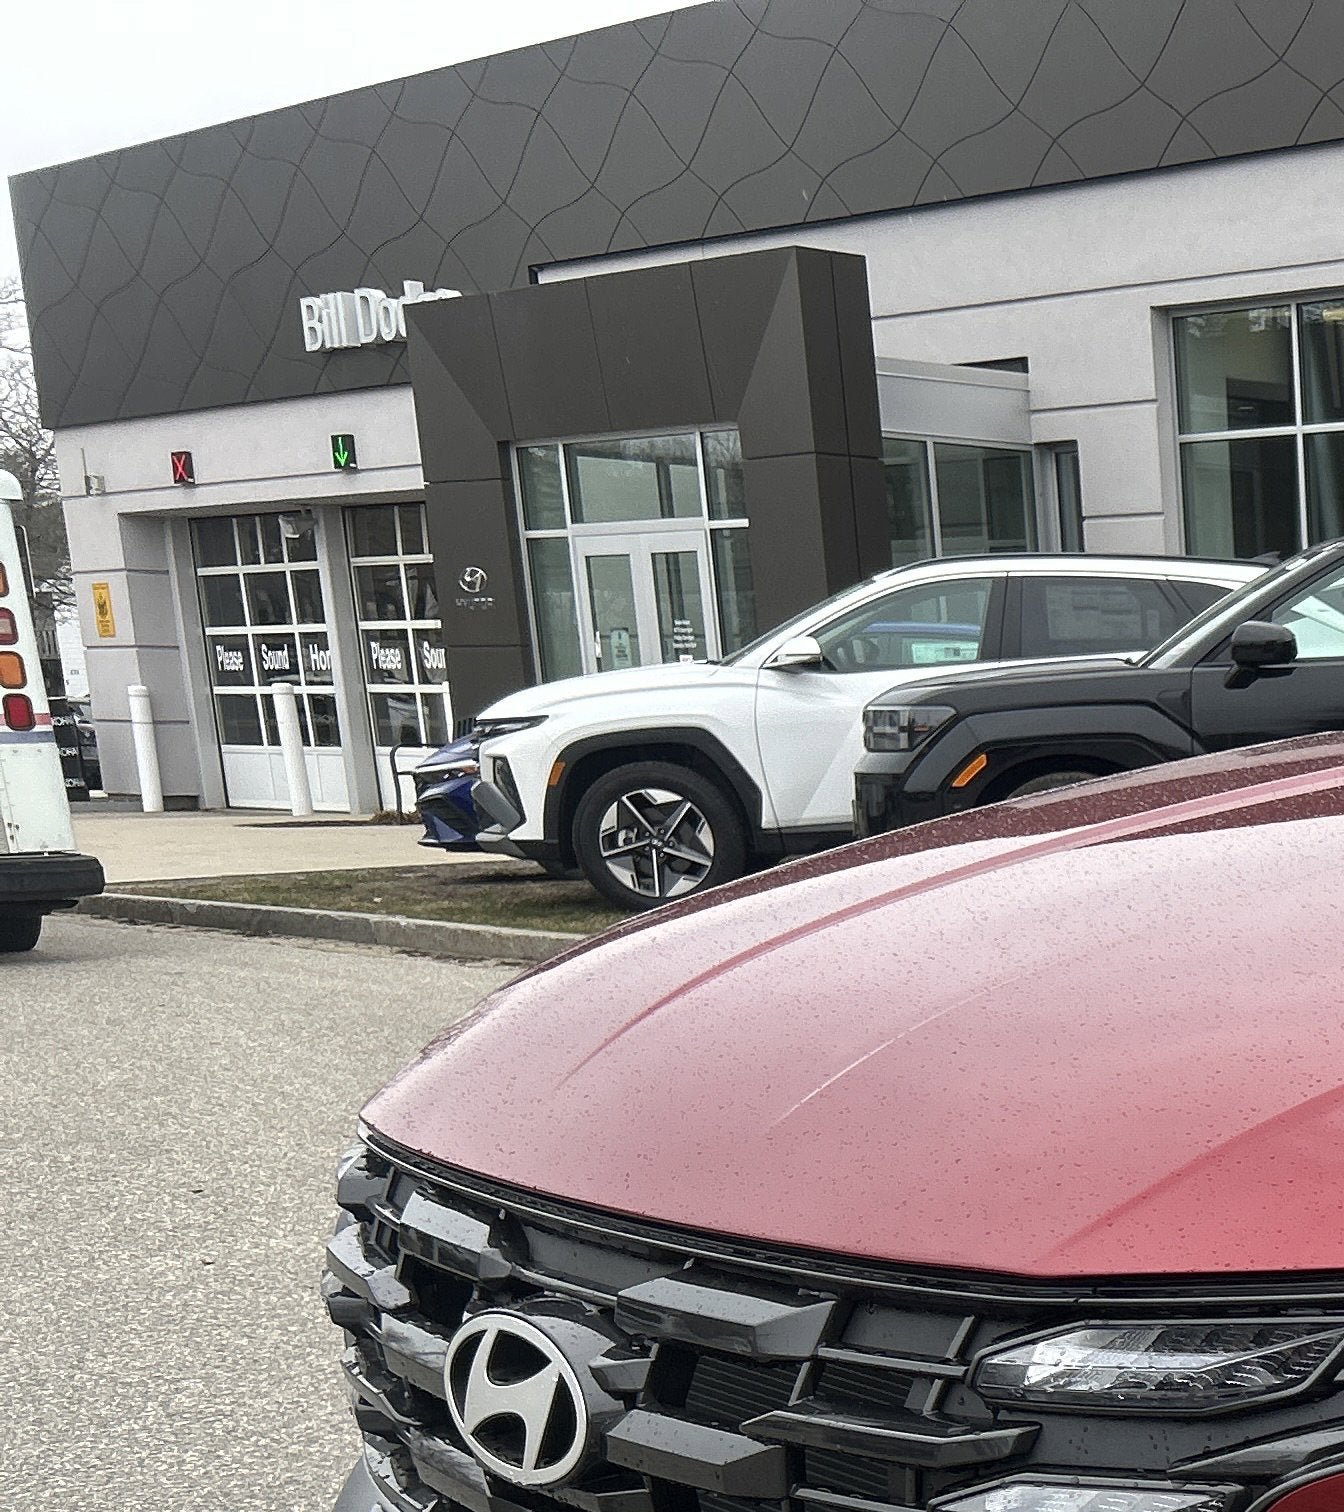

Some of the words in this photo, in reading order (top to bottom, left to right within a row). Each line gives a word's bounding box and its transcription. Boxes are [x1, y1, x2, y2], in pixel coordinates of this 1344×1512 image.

[300, 291, 361, 351] Bill
[216, 643, 244, 671] Please
[262, 643, 290, 671] Sound
[309, 643, 331, 671] Hor
[371, 641, 401, 670] Please
